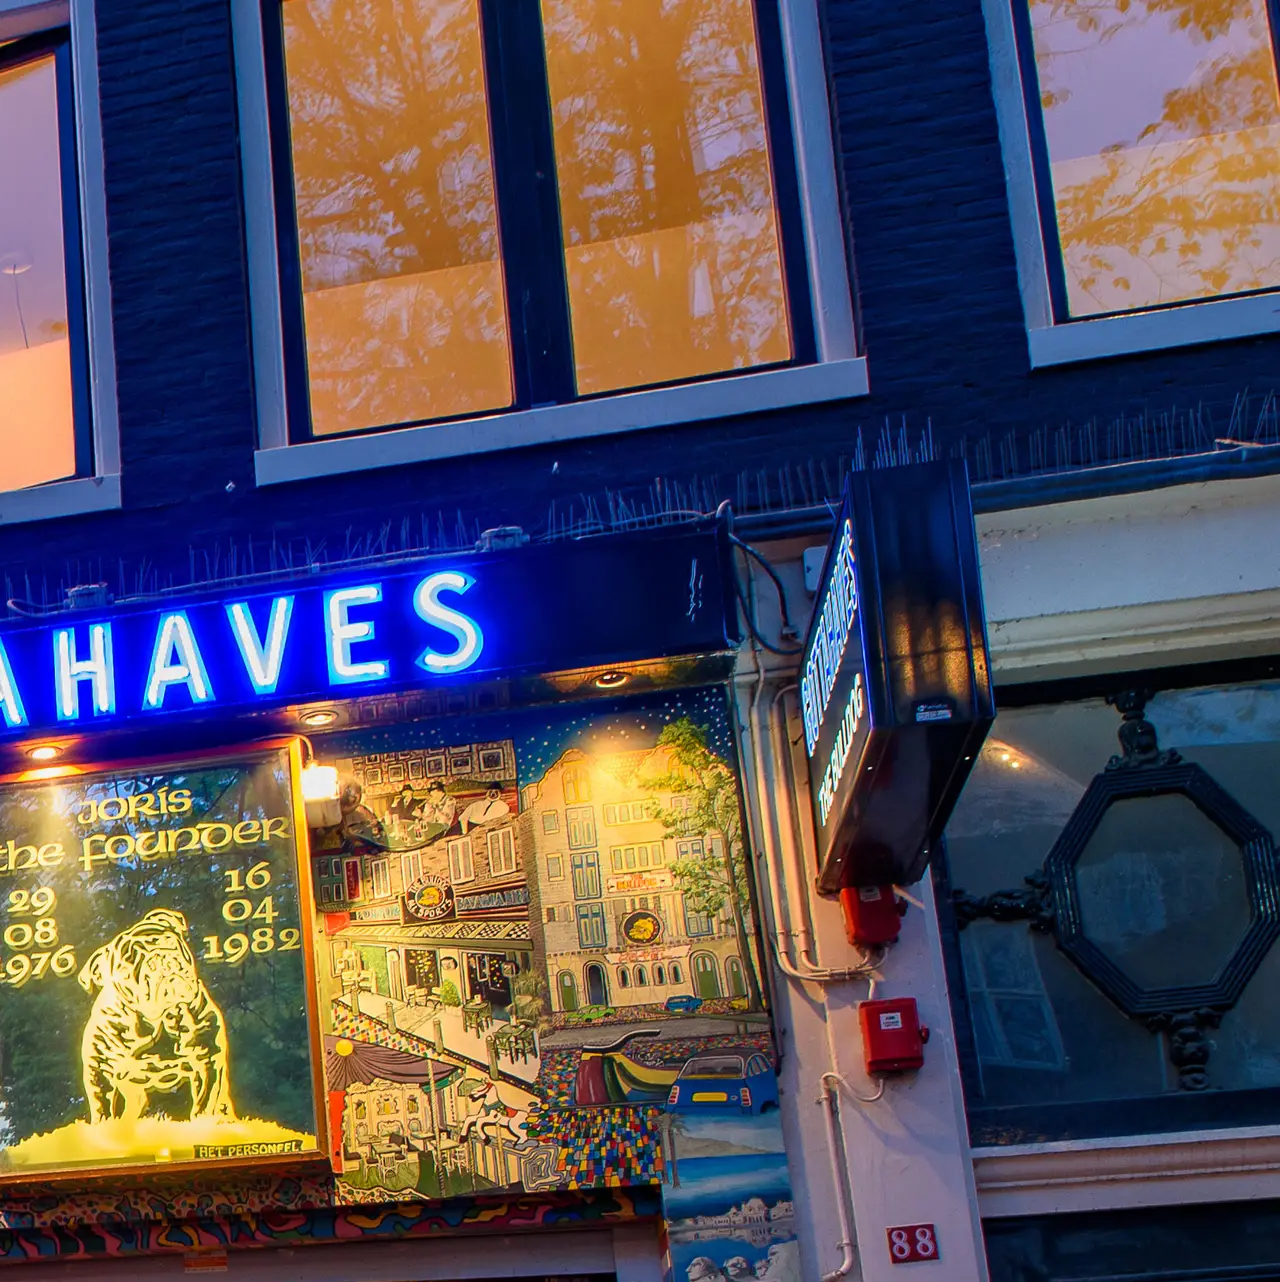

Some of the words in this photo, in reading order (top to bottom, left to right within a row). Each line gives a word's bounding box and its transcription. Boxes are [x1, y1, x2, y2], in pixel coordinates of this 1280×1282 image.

[819, 763, 834, 826] THE
[831, 672, 863, 793] BULLDOG
[77, 816, 292, 873] founder
[223, 861, 272, 895] 16
[6, 886, 58, 916] 29
[221, 893, 280, 926] 04
[417, 898, 452, 918] SPORTS
[4, 917, 60, 950] 08
[201, 927, 302, 966] 1982
[198, 1144, 225, 1159] HET
[890, 1226, 937, 1260] 88
